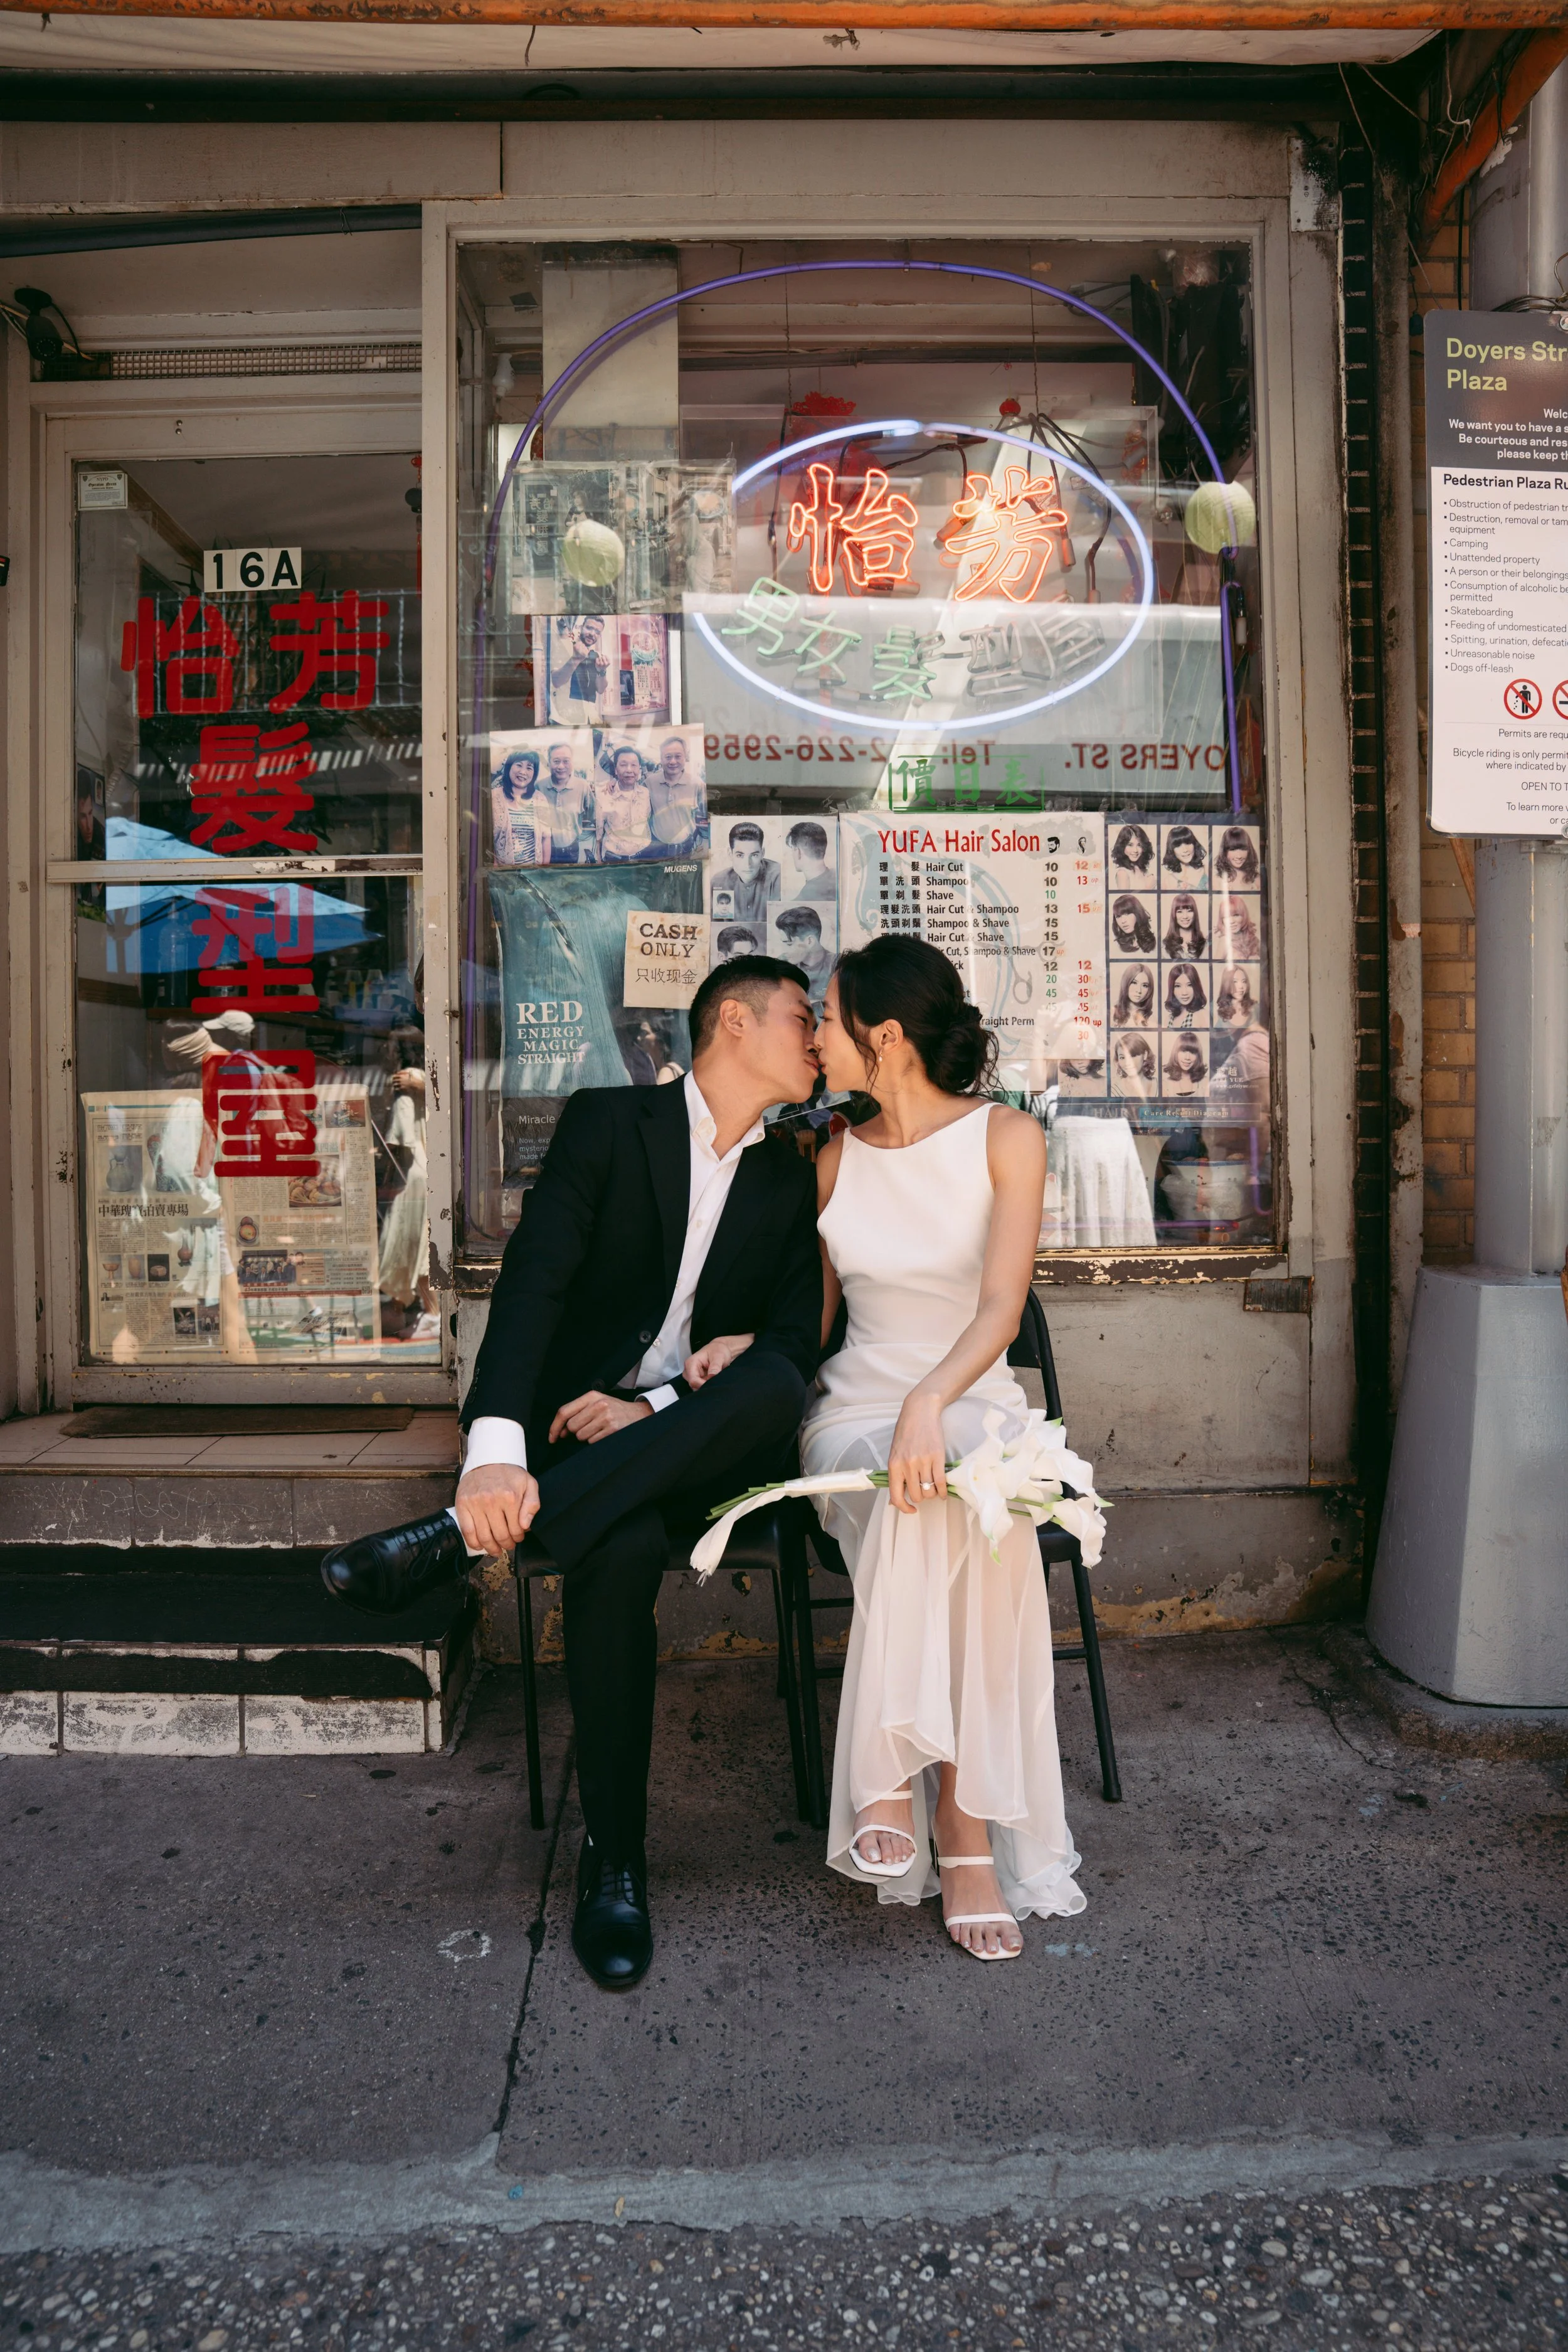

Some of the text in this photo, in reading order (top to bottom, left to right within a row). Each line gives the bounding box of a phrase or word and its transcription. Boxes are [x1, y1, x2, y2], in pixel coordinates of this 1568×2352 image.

[1447, 337, 1568, 363] Doyers Str
[1447, 369, 1507, 391] Plaza
[1449, 419, 1465, 429] We
[1466, 421, 1492, 430] want
[1495, 423, 1513, 432] you
[1515, 423, 1527, 432] to
[1528, 422, 1553, 432] have
[1459, 433, 1567, 447] Be courteous and res
[1497, 448, 1531, 460] please
[1534, 450, 1558, 462] keep
[1444, 474, 1513, 488] Pedestrian
[1517, 477, 1551, 489] Plaza
[1449, 499, 1501, 509] Obstruction
[1503, 501, 1512, 509] of
[1513, 502, 1559, 512] pedestrian
[1449, 513, 1503, 524] Destruction,
[1505, 516, 1539, 525] removal
[788, 462, 1068, 604] 怡芳
[1449, 525, 1495, 535] equipment
[1449, 538, 1488, 549] Camping
[1449, 553, 1540, 565] Unattended property
[212, 549, 298, 590] 16A
[1449, 567, 1456, 575] A
[1502, 569, 1521, 577] their
[1523, 569, 1568, 581] belongings
[1450, 581, 1507, 592] Consumption
[1510, 583, 1518, 591] of
[1520, 584, 1558, 593] alcoholic
[1450, 593, 1493, 602] permitted
[1451, 607, 1513, 618] Skateboarding
[1451, 620, 1567, 633] Feeding of undomesticated
[1451, 634, 1486, 645] Spitting,
[1490, 637, 1530, 647] urination,
[120, 590, 390, 719] 怡芳
[1451, 649, 1510, 659] Unreasonable
[1451, 663, 1513, 673] Dogs off-leash
[1499, 729, 1531, 738] Permits
[1549, 731, 1568, 740] requ
[1453, 748, 1484, 759] Bicycle
[1486, 749, 1510, 760] riding
[1513, 750, 1520, 758] is
[1522, 750, 1540, 760] only
[1486, 761, 1566, 772] where indicated by
[896, 758, 1038, 805] 價目表
[1521, 781, 1562, 791] OPEN TO
[1506, 802, 1515, 811] To
[1518, 802, 1539, 811] learn
[877, 829, 1041, 853] YUFA Hair Salon
[664, 865, 698, 873] MUGENS
[926, 861, 1088, 872] Hair Cut 10 12
[926, 877, 969, 887] Shampoo
[1044, 877, 1057, 886] 10
[1077, 876, 1088, 885] 13
[926, 891, 953, 900] Shave
[1045, 890, 1056, 899] 10
[927, 905, 946, 914] Hair
[948, 905, 964, 914] Cut
[977, 904, 1019, 915] Shampoo
[1045, 904, 1058, 913] 13
[1078, 903, 1090, 913] 15
[927, 919, 969, 930] Shampoo
[973, 919, 980, 928] &
[982, 918, 1009, 928] Shave
[1046, 918, 1058, 928] 15
[640, 923, 698, 940] CASH
[928, 933, 946, 942] Hair
[949, 933, 965, 942] Cut
[977, 933, 1004, 941] Shave
[1044, 931, 1059, 941] 15
[189, 722, 322, 1178] 髮型屋
[640, 942, 695, 958] ONLY
[946, 946, 961, 957] Cut,
[964, 947, 1002, 957] Sampoo
[1004, 946, 1010, 955] &
[1012, 946, 1036, 956] Shave
[1042, 946, 1056, 956] 17
[1044, 960, 1092, 972] 12 12
[635, 968, 697, 984] 只收现金
[1046, 975, 1089, 983] 20 30
[1046, 988, 1089, 997] 45 45
[516, 1000, 583, 1024] RED
[1078, 1002, 1089, 1012] 45
[1012, 1017, 1101, 1027] Perm 120 up
[517, 1025, 585, 1039] ENERGY
[1078, 1030, 1089, 1040] 30
[523, 1039, 578, 1052] MAGIC
[518, 1052, 585, 1064] STRAIGHT
[1094, 1108, 1128, 1118] HAIR
[519, 1115, 556, 1125] Miracle
